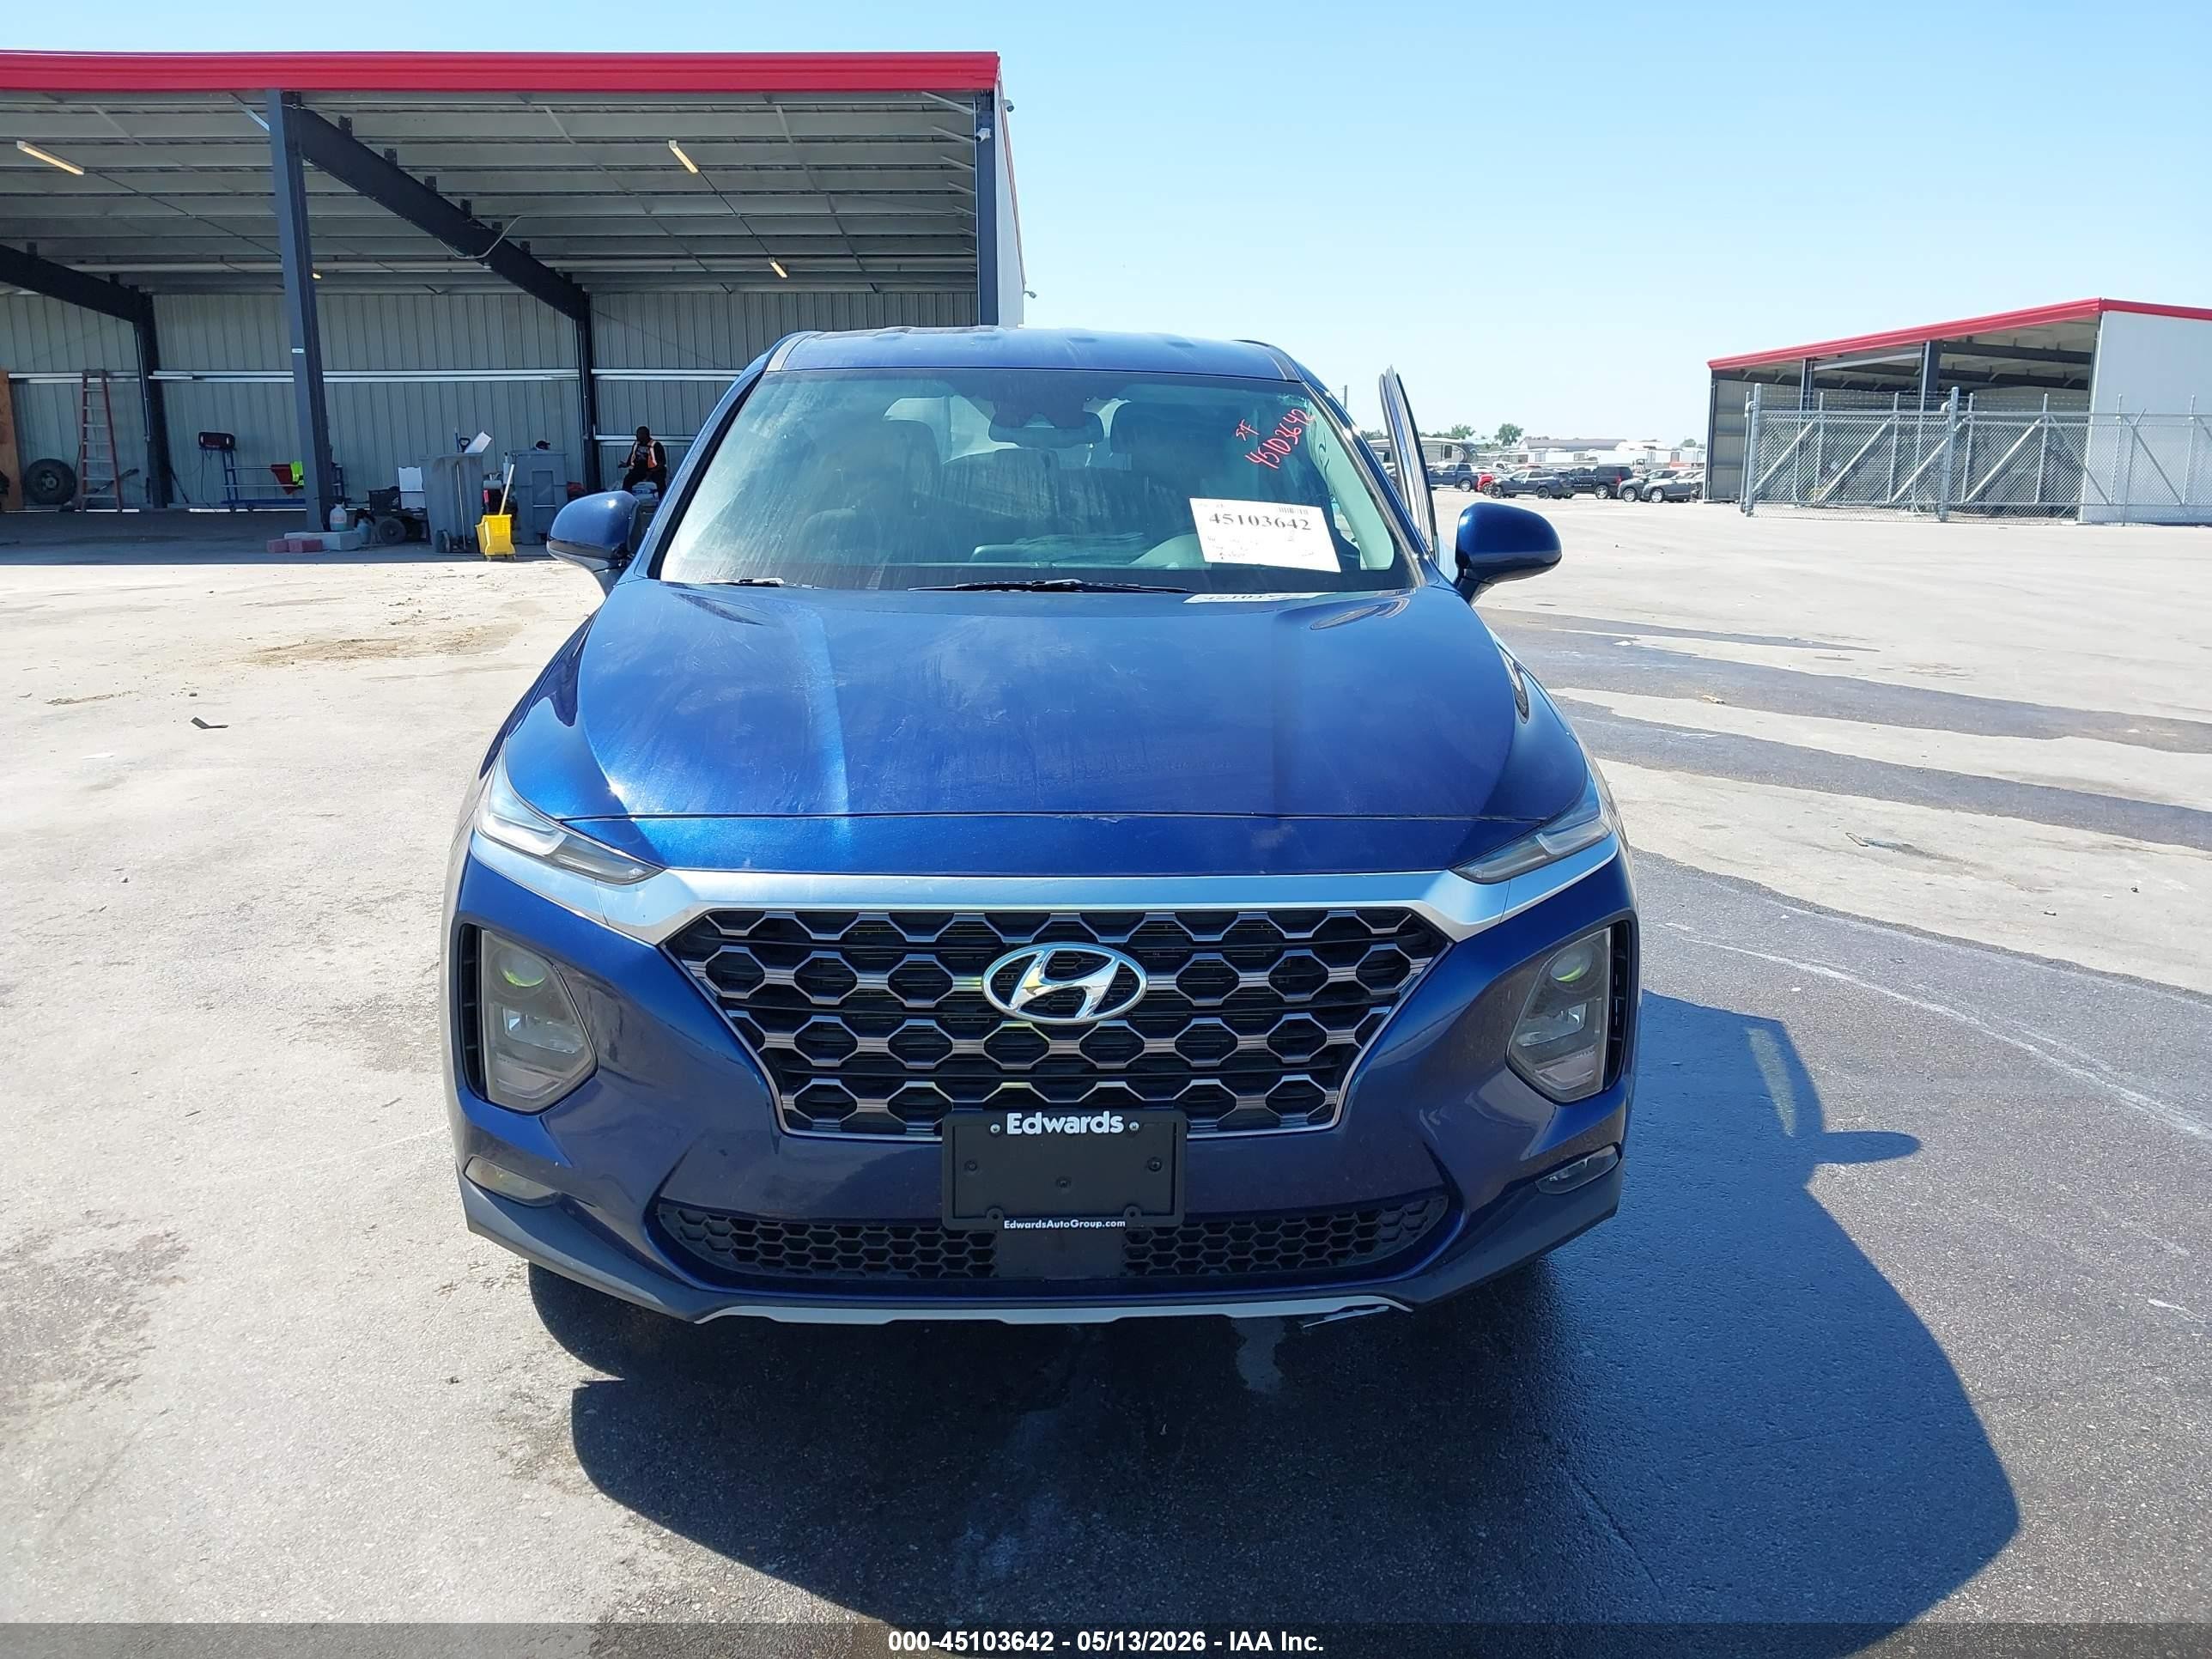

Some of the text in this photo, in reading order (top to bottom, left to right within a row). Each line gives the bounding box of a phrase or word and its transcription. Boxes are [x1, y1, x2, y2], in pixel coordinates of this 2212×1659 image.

[1244, 408, 1316, 469] 45103642
[1208, 513, 1312, 531] 45103642
[1006, 1110, 1125, 1135] Edwards
[1004, 1218, 1126, 1230] EdwardsAutoGroup.com
